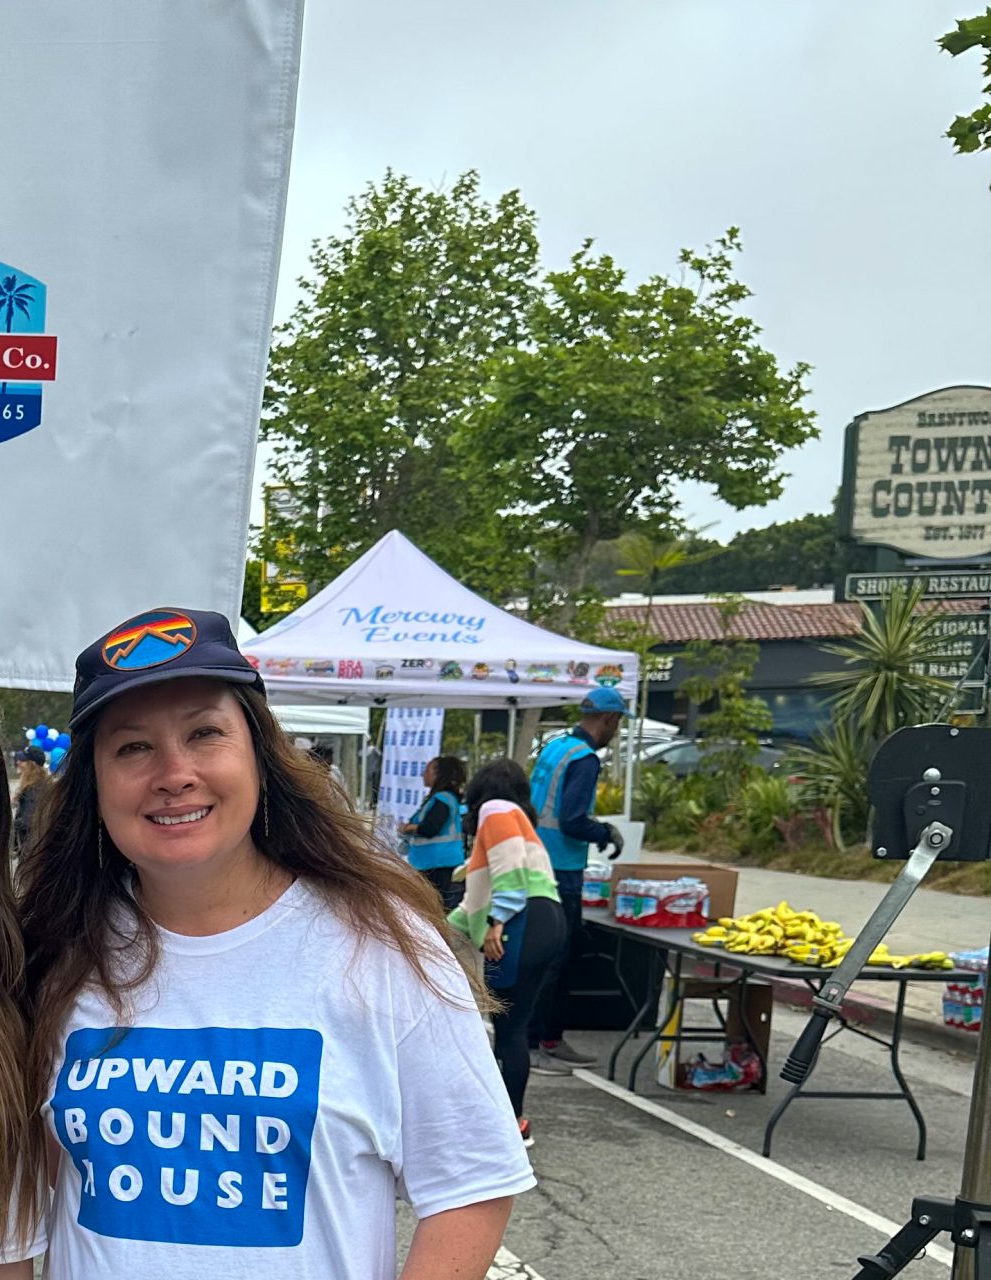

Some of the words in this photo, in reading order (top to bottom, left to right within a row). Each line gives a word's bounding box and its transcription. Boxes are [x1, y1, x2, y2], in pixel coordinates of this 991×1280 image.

[2, 346, 50, 369] Co.
[888, 436, 991, 475] TOWN
[872, 480, 991, 518] COUNT
[338, 605, 486, 631] Mercury
[360, 626, 484, 644] Events
[67, 1058, 298, 1098] UPWARD
[64, 1107, 291, 1155] BOUND
